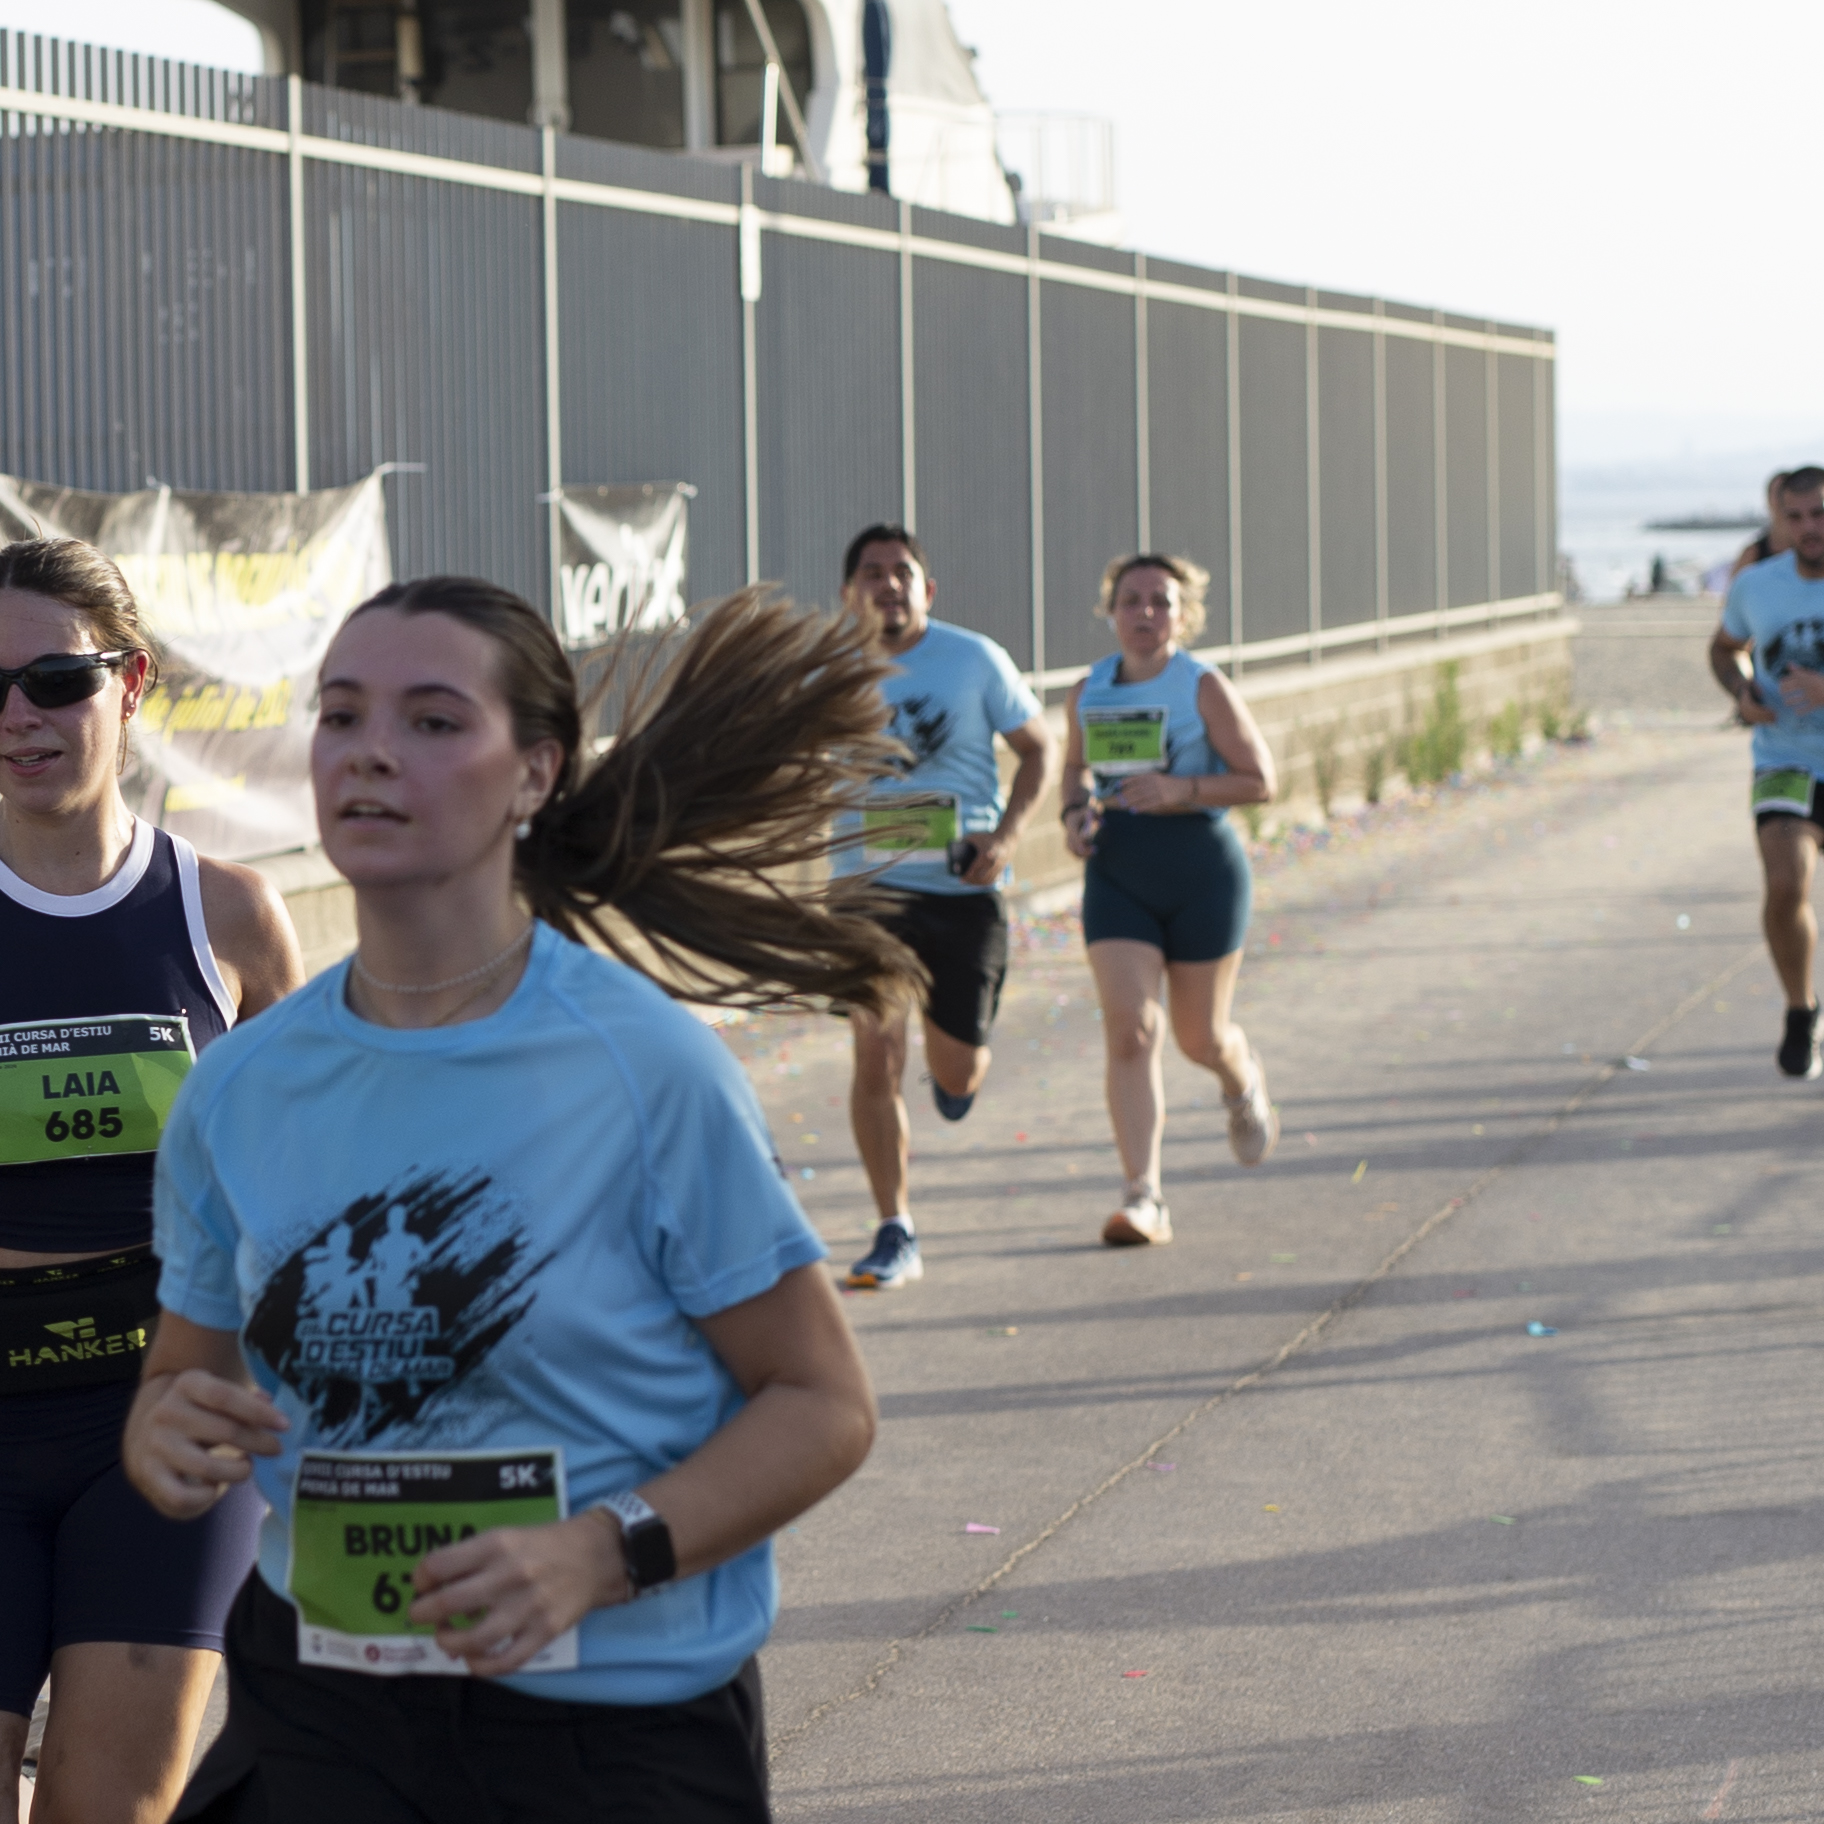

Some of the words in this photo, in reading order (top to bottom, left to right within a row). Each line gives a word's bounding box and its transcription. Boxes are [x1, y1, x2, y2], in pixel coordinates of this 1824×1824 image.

[13, 1028, 56, 1043] CURSA
[59, 1025, 112, 1039] D'ESTIU
[148, 1026, 175, 1043] 5K
[20, 1044, 39, 1055] DE
[41, 1042, 71, 1054] MAR
[42, 1069, 122, 1100] LAIA
[45, 1107, 124, 1143] 685
[327, 1311, 434, 1336] CURSA
[498, 1462, 539, 1491] 5K
